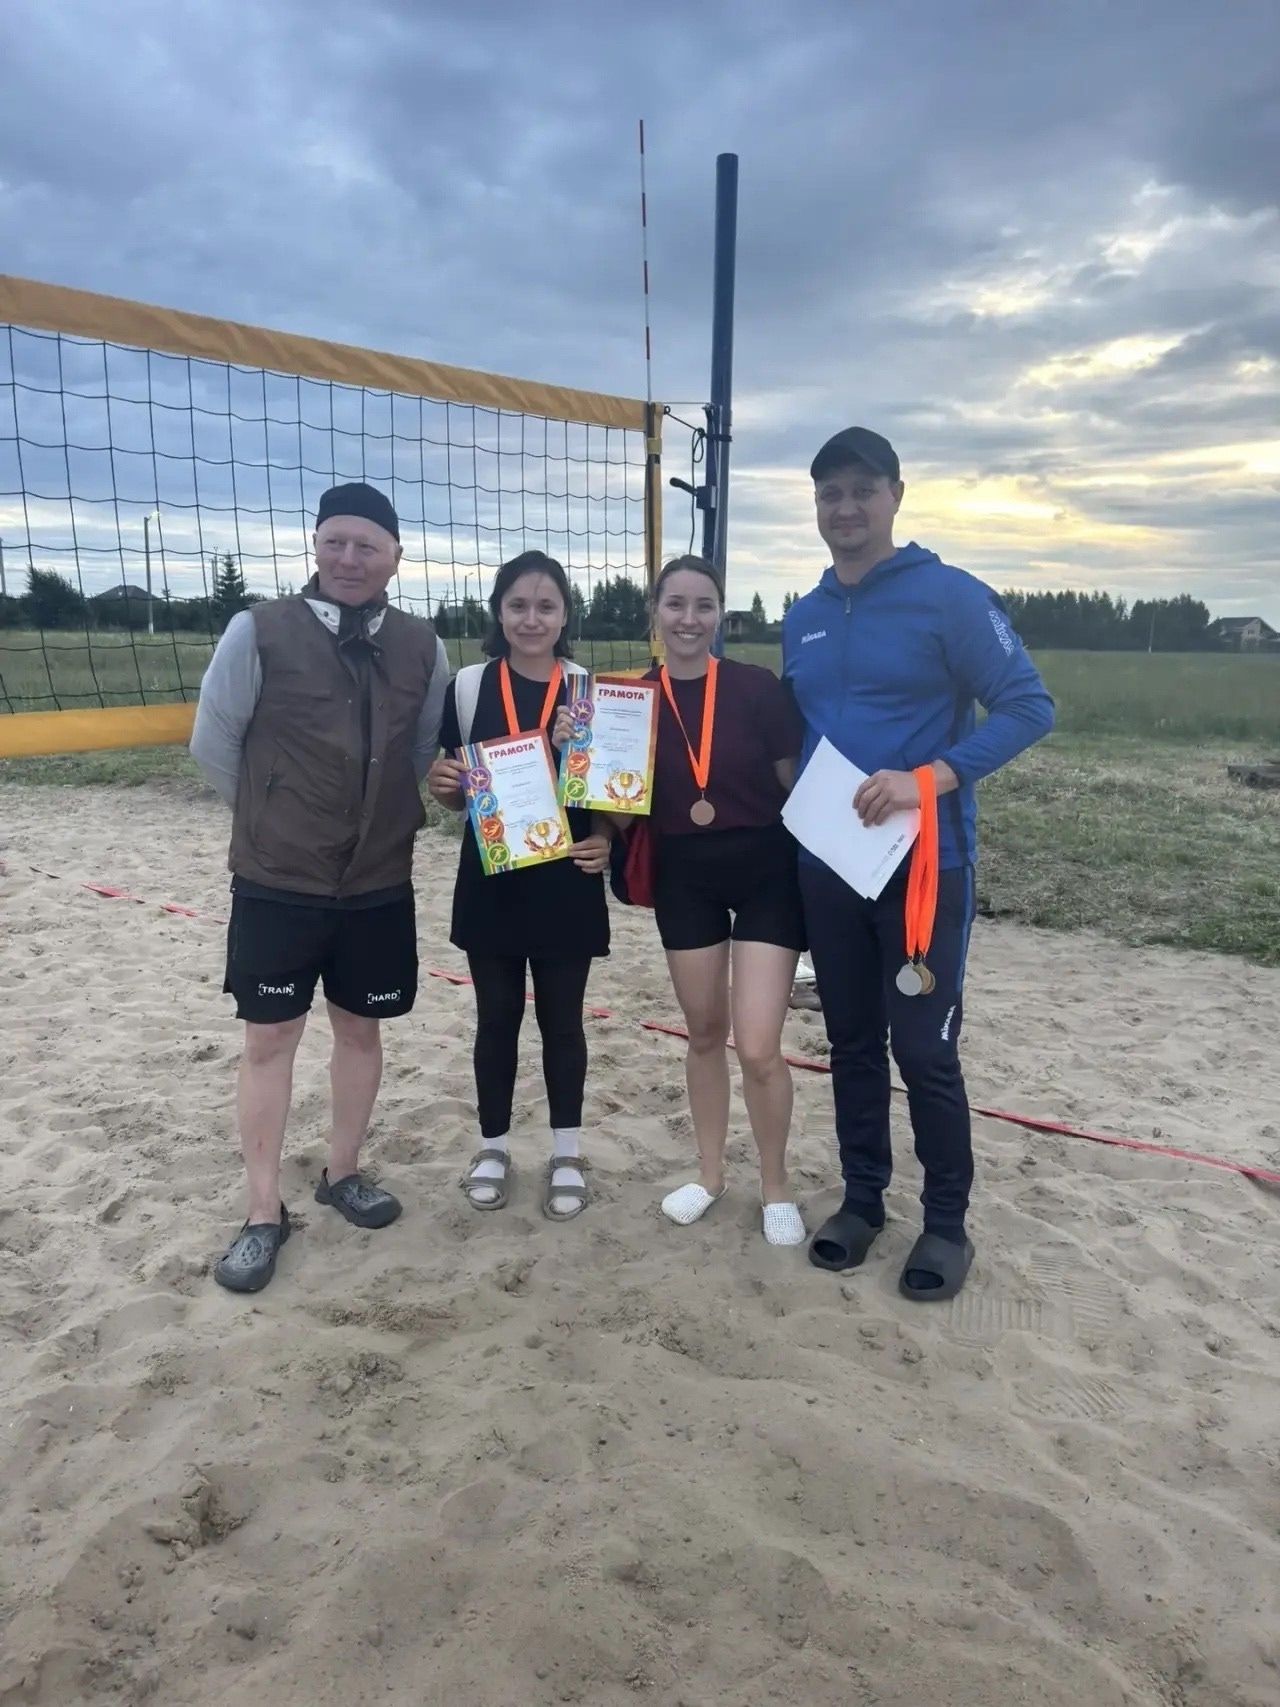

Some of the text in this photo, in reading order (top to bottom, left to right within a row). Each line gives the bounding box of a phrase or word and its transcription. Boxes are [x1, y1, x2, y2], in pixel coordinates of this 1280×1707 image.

[598, 688, 645, 700] ГРАМОТА
[488, 743, 536, 760] ГРАМОТА
[260, 984, 293, 995] TRAIN
[370, 991, 398, 1002] HARD
